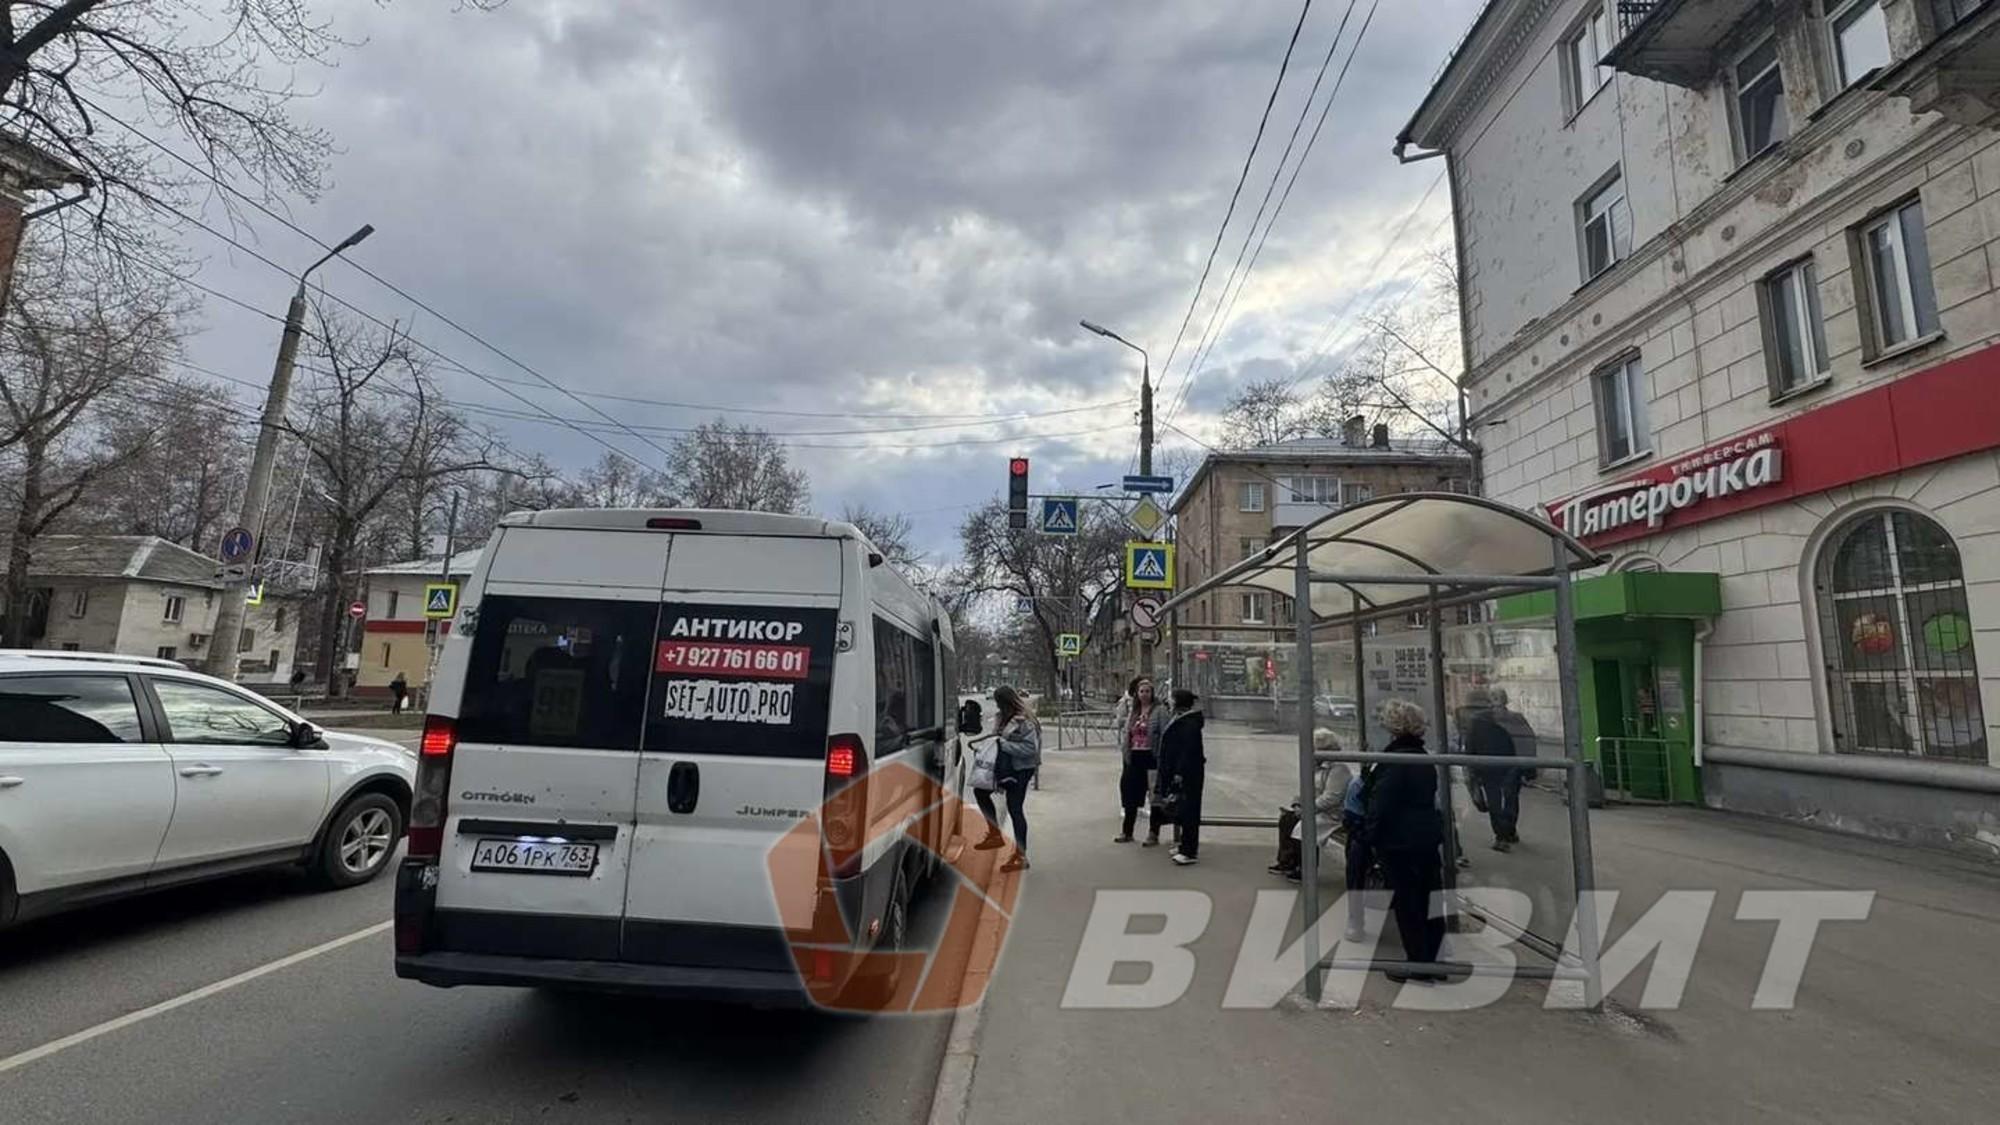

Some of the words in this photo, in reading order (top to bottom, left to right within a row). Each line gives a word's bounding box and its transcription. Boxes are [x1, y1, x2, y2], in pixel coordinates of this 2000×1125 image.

[671, 617, 803, 641] АНТИКОР
[665, 647, 687, 666] +7
[688, 647, 721, 667] 927
[722, 648, 752, 669] 761
[754, 651, 779, 670] 66
[781, 652, 803, 671] 01
[667, 685, 792, 717] SET-AUTO.PRO
